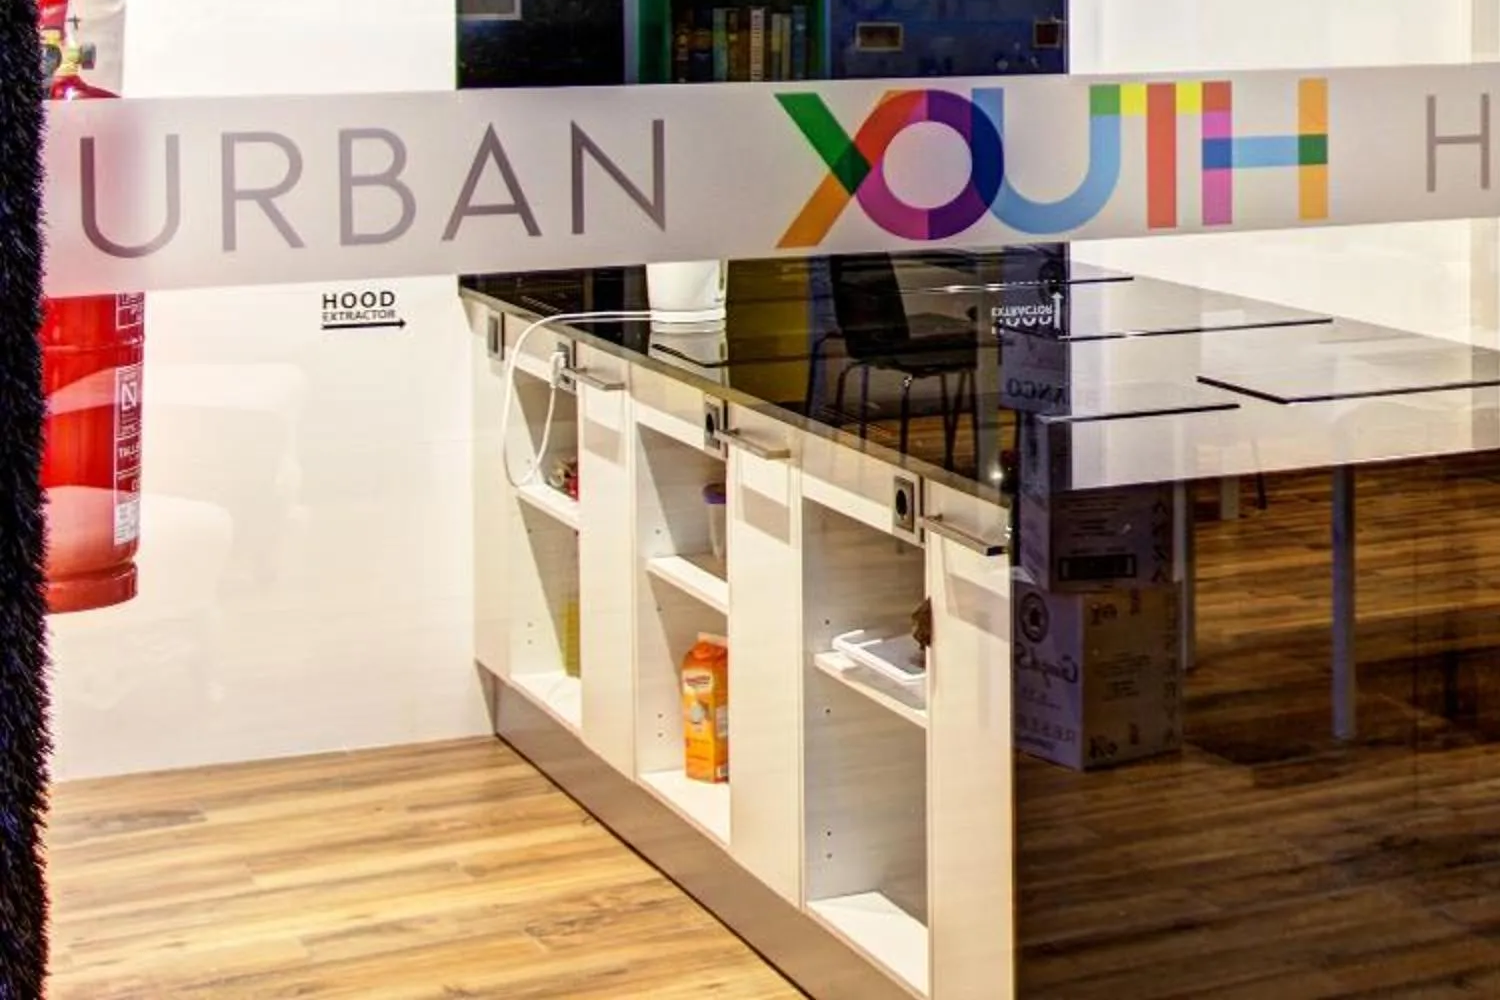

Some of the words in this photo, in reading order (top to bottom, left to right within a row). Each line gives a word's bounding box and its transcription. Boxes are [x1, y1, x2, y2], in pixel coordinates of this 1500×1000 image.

[79, 118, 667, 259] URBAN
[774, 77, 1329, 249] YOUTH
[322, 291, 396, 309] HOOD
[322, 309, 396, 321] EXTRACTOR
